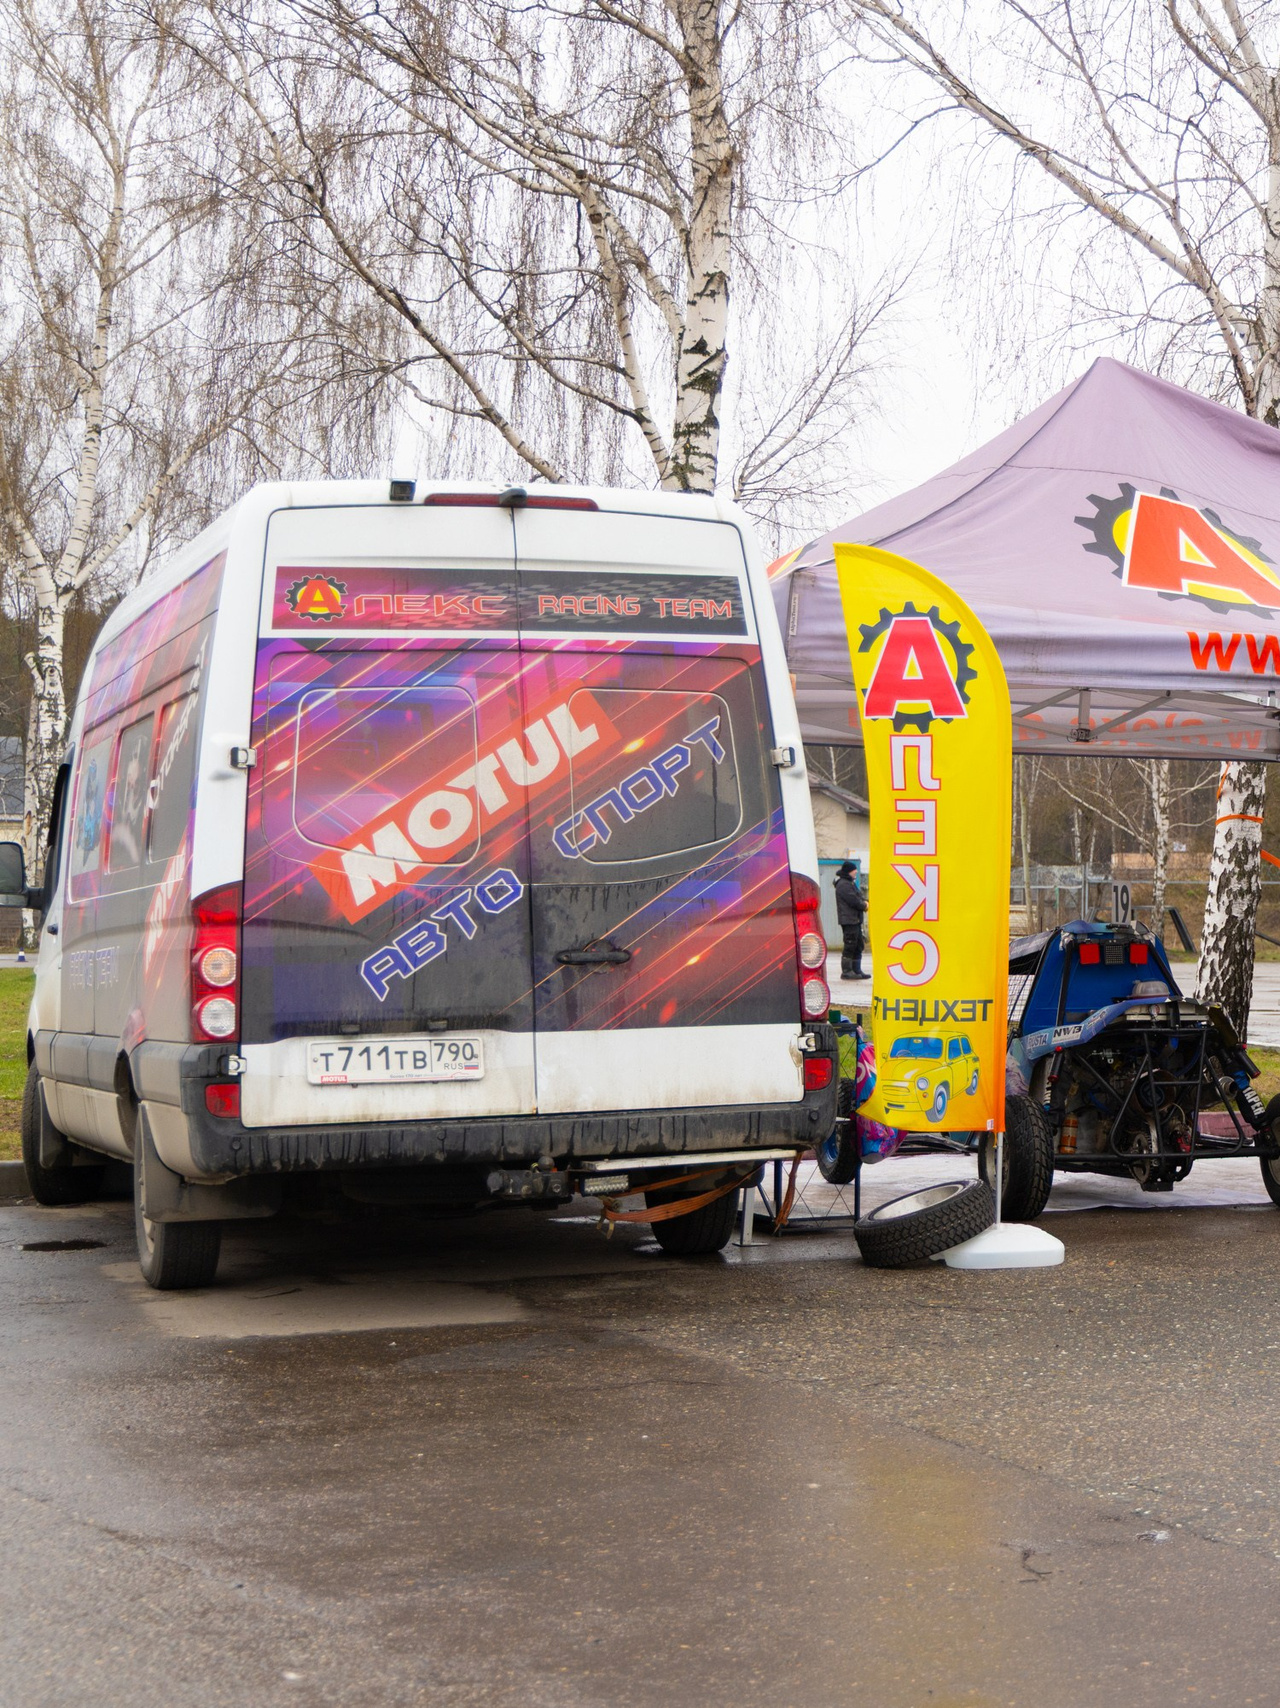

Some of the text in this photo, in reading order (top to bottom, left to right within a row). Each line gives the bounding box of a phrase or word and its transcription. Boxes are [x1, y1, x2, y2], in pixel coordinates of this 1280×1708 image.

[538, 593, 733, 620] RACING TEAM
[340, 703, 600, 907] MOTUL
[361, 715, 726, 1002] АВТО СПОРТ
[1113, 884, 1130, 924] 19
[320, 1042, 475, 1072] Т711ТВ 790
